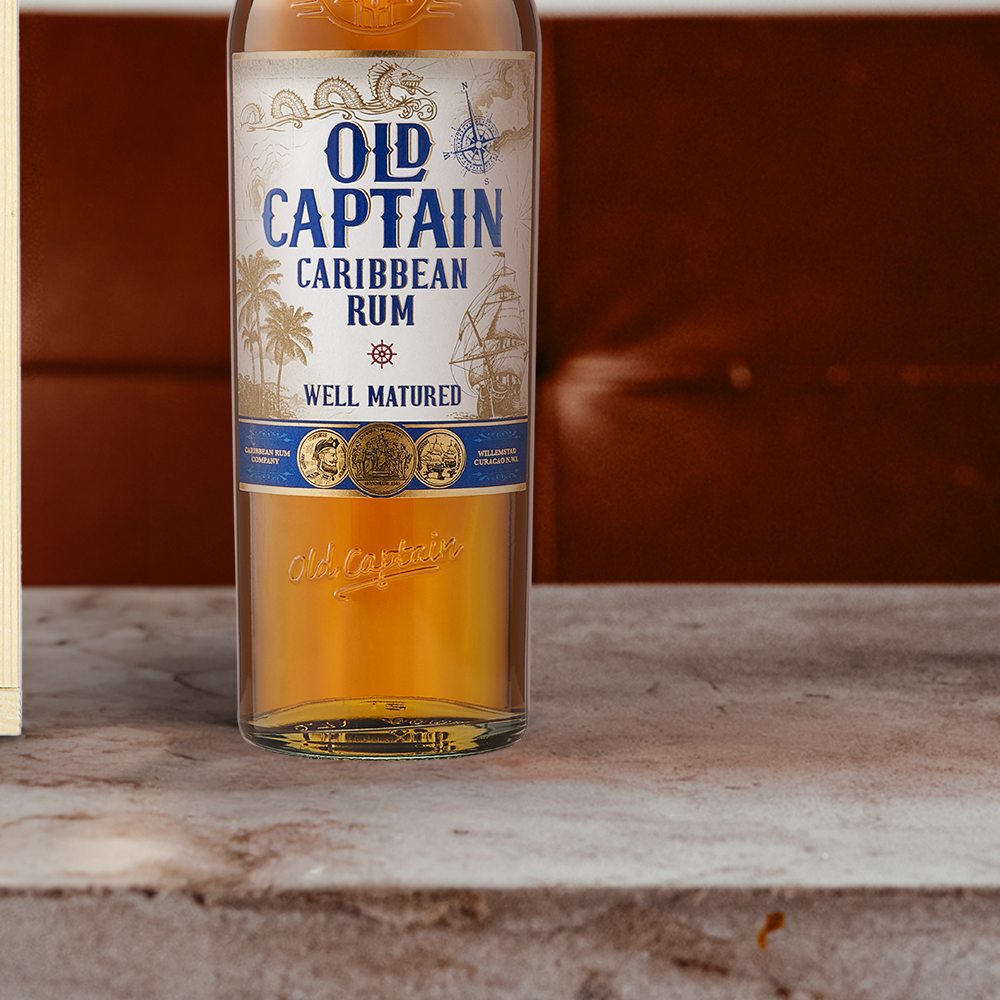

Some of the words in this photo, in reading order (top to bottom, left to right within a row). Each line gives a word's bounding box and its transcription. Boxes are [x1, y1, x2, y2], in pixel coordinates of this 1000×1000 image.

[324, 121, 436, 183] OLD
[261, 188, 503, 249] CAPTAIN
[296, 257, 468, 290] CARIBBEAN
[347, 294, 415, 327] RUM
[303, 384, 360, 407] WELL
[367, 384, 462, 407] MATURED
[251, 456, 280, 465] COMPANY
[274, 449, 291, 457] RUM
[477, 447, 517, 457] WILLEMSTAD
[288, 542, 341, 584] Old
[343, 530, 464, 590] Captain
